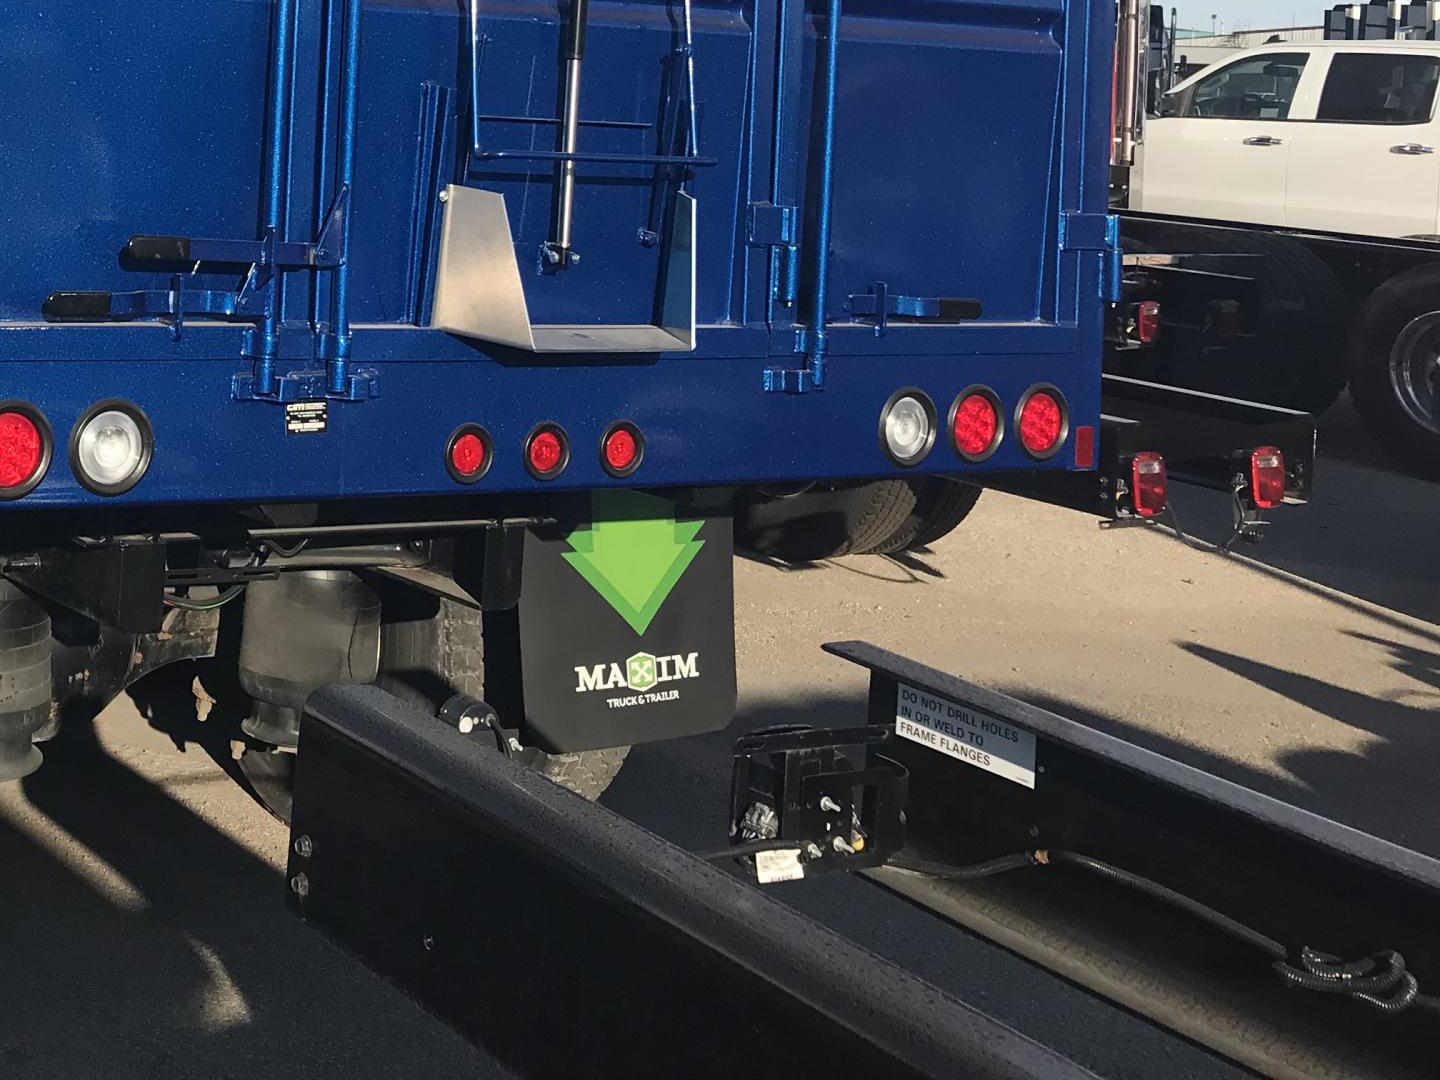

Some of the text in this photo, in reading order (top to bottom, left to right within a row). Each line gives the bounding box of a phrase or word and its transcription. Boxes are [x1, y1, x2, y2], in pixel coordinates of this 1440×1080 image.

[574, 652, 699, 692] MAXIM
[606, 696, 638, 709] TRUCK
[645, 690, 680, 703] TRAILER
[902, 689, 1019, 743] DO NOT DRILL HOLES
[900, 721, 991, 767] FRAME FLANGES
[901, 705, 984, 747] IN OR WELD TO
